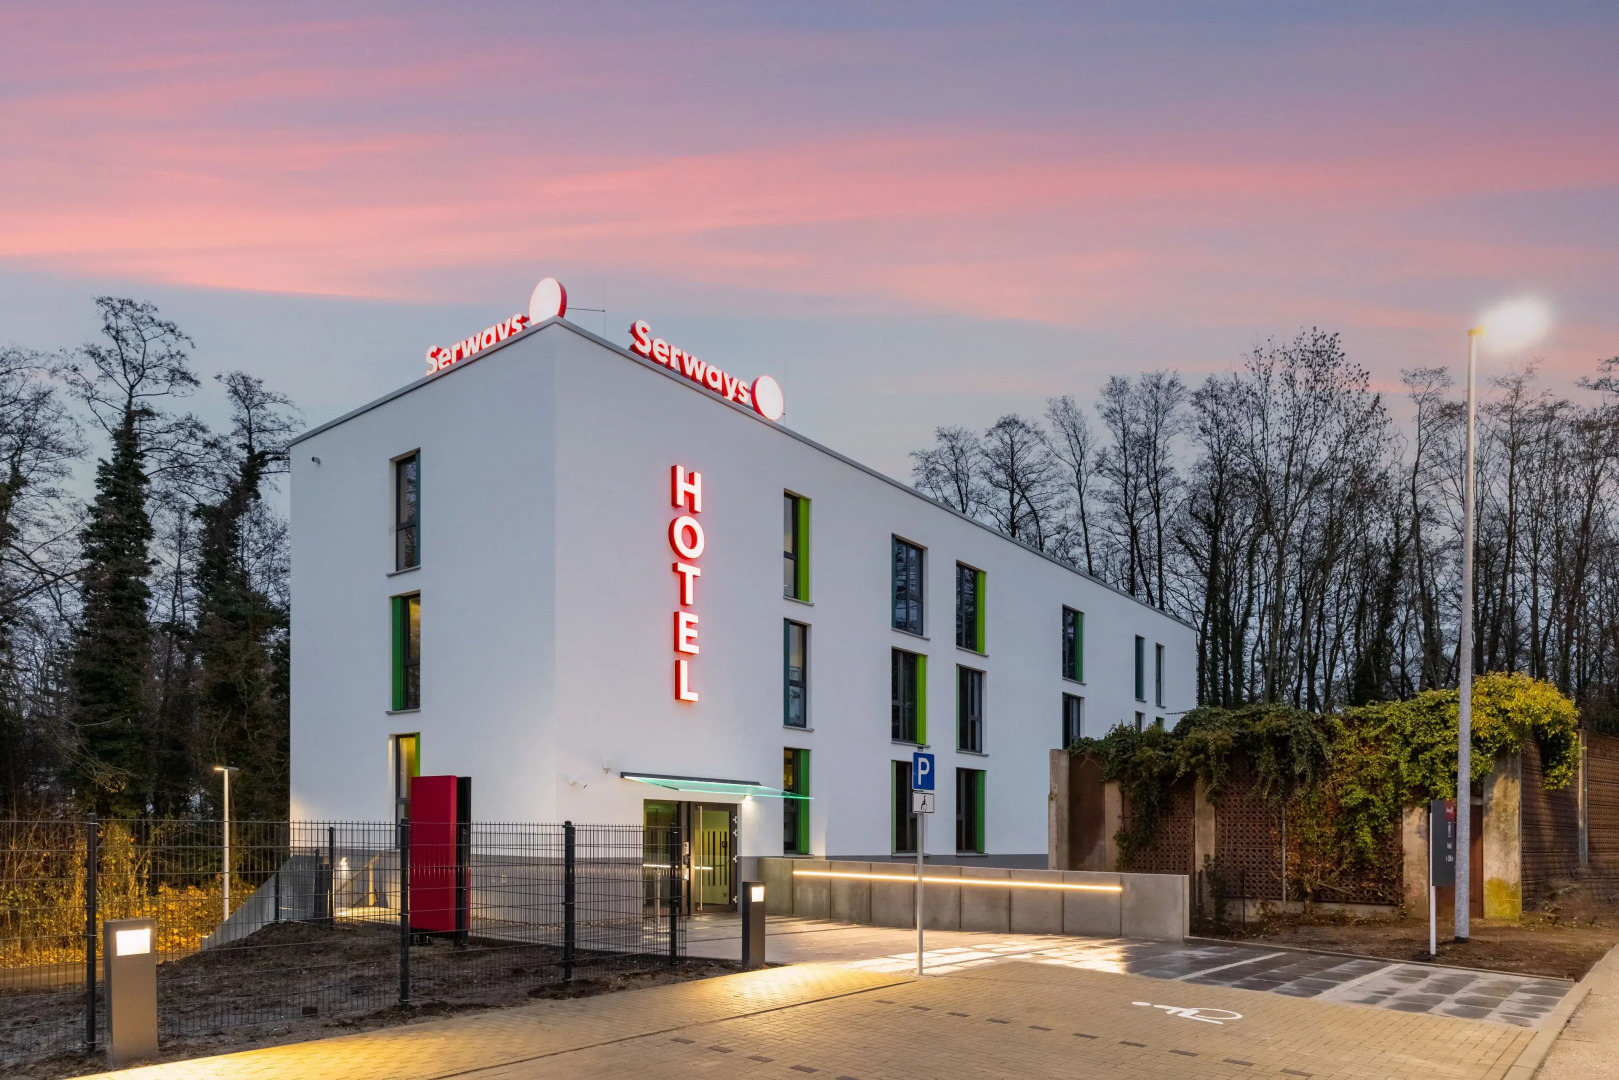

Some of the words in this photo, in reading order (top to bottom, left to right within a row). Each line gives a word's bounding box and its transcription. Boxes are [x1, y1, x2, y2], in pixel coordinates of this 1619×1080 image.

[426, 313, 526, 376] Serways
[630, 319, 750, 404] Serways
[669, 464, 705, 702] HOTEL
[917, 757, 930, 785] P
